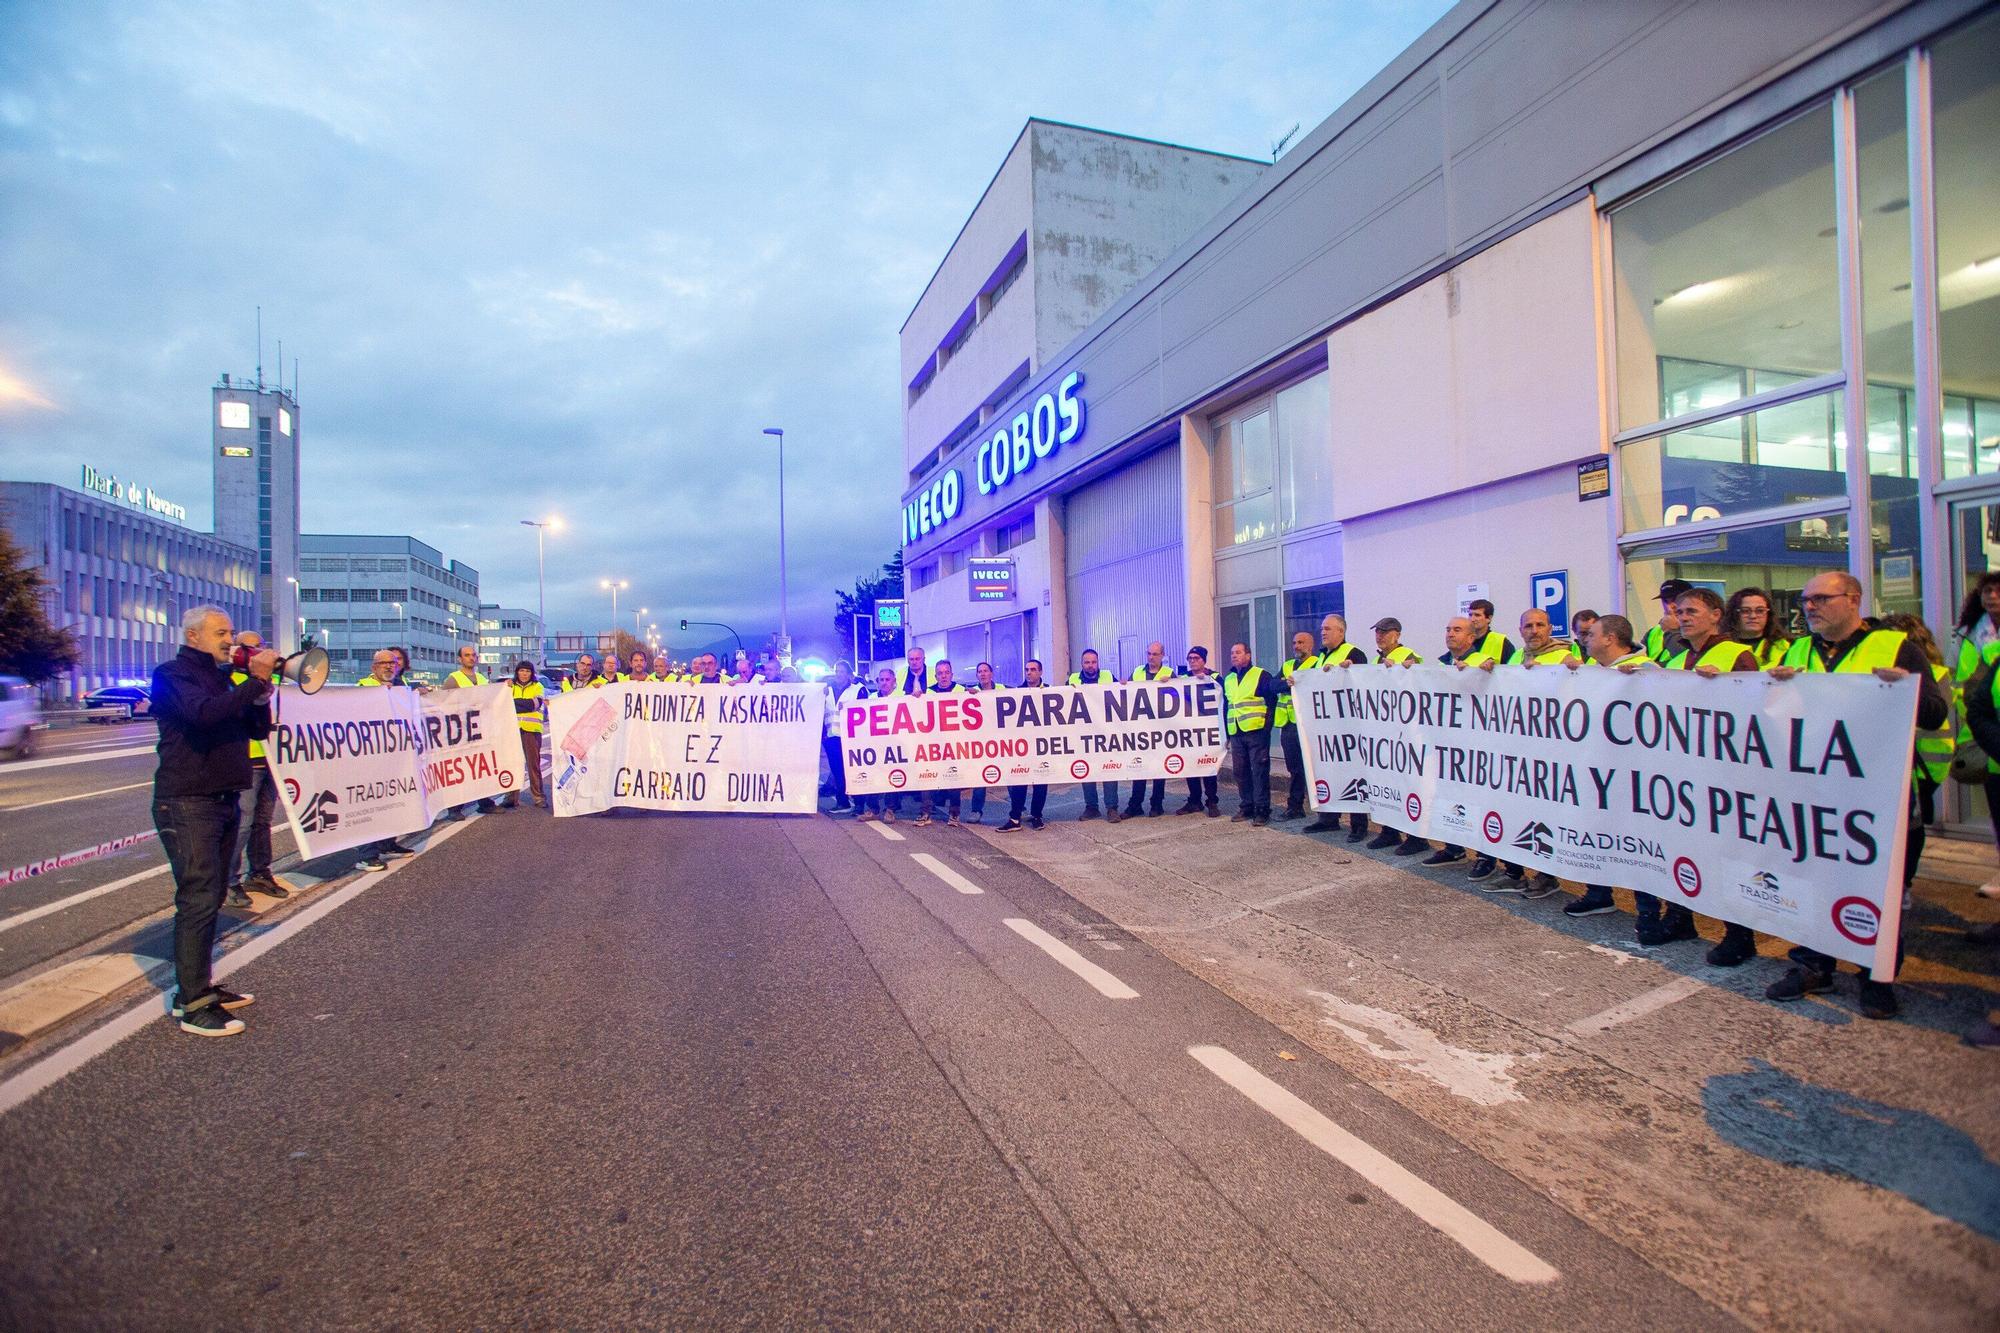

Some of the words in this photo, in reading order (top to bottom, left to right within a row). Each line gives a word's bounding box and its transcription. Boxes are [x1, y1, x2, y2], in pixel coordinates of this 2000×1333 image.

[902, 469, 960, 547] IVECO
[977, 371, 1083, 496] COBOS
[83, 464, 124, 499] Diario
[128, 481, 142, 505] de
[145, 487, 186, 520] Navarra
[973, 570, 1009, 580] IVECO
[1536, 578, 1564, 611] P
[624, 693, 705, 723] BALDINTZA
[719, 694, 806, 724] KASKARRIK
[847, 698, 984, 738] PEAJES
[996, 692, 1092, 728] PARA
[1104, 683, 1219, 722] NADIE
[685, 734, 723, 763] EZ
[849, 748, 877, 767] NO
[883, 746, 908, 764] AL
[915, 738, 1029, 762] ABANDONO
[1036, 736, 1074, 756] DEL
[1081, 727, 1220, 753] TRANSPORTE
[1312, 691, 1330, 720] EL
[1332, 688, 1463, 728] TRANSPORTE
[1471, 694, 1590, 742] NAVARRO
[1602, 700, 1773, 769] CONTRA
[1789, 717, 1865, 779] LA
[613, 767, 706, 801] GARRAIO
[728, 772, 784, 802] DUINA
[1435, 745, 1579, 806] TRIBUTARIA
[1589, 767, 1616, 810] Y
[1631, 769, 1696, 827] LOS
[1708, 785, 1878, 866] PEAJES
